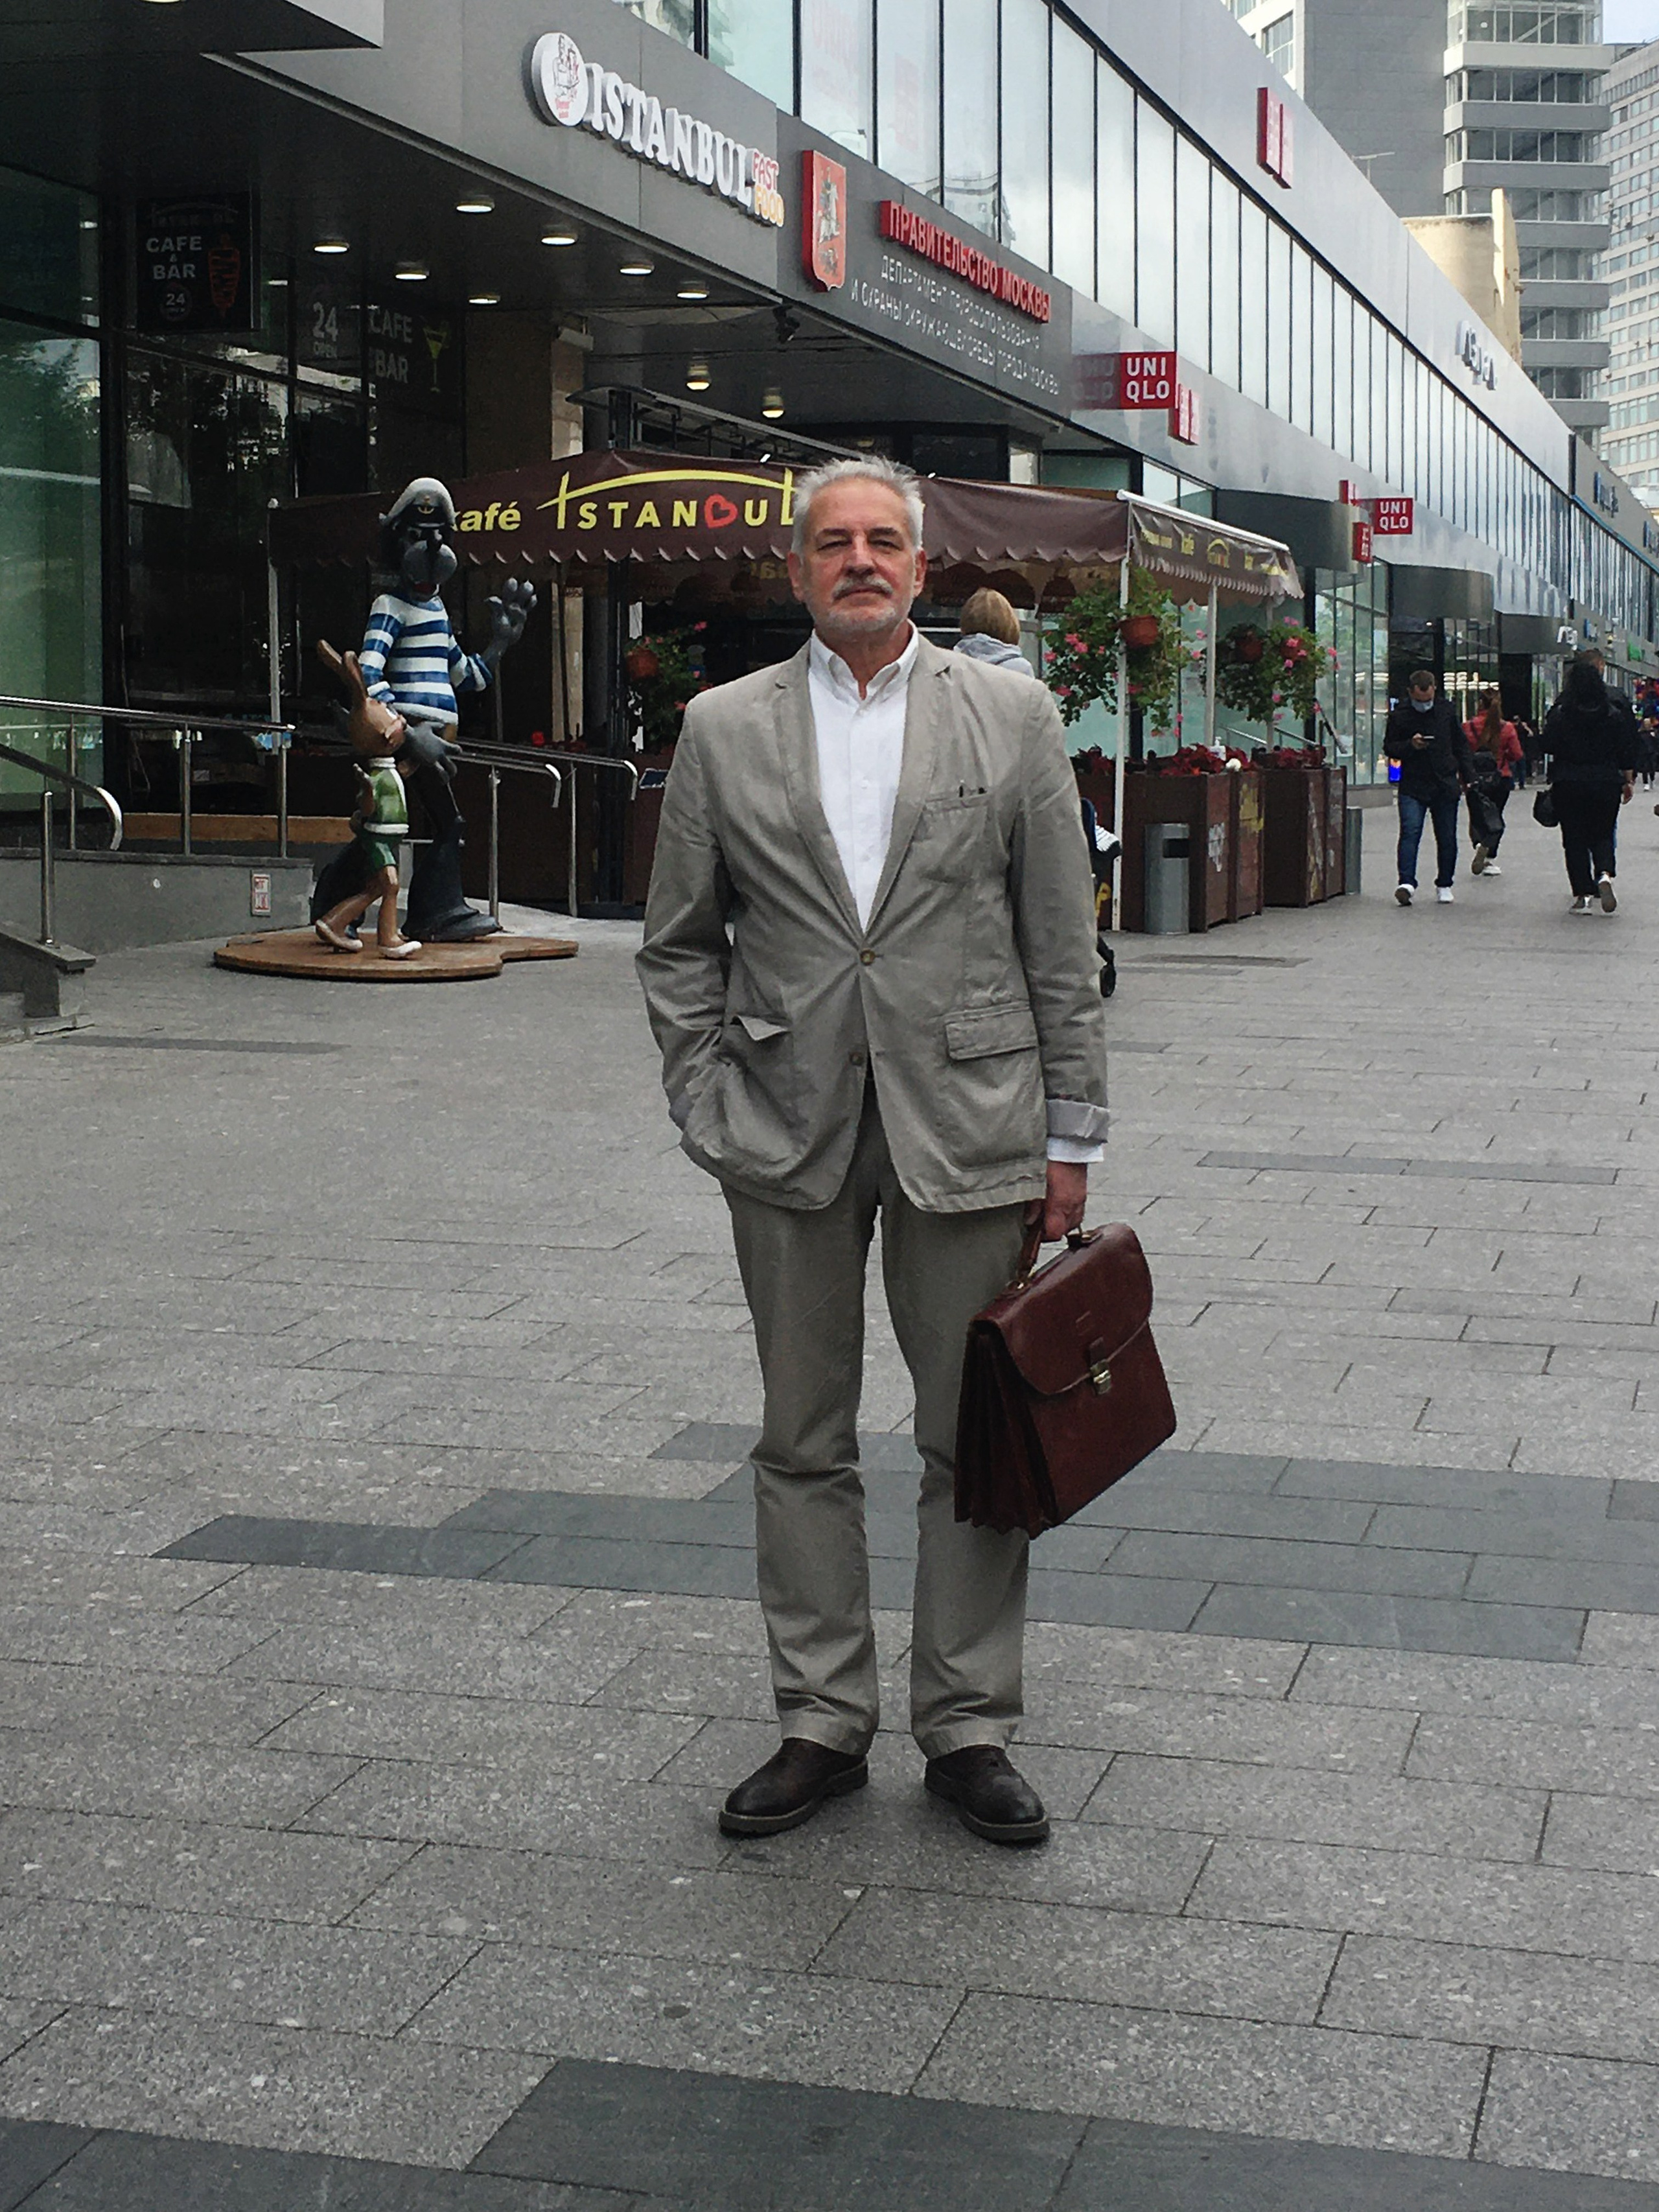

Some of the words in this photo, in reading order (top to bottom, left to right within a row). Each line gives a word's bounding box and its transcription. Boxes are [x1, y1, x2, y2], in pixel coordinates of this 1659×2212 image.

[588, 63, 752, 207] ISTANBUL
[752, 150, 778, 191] FAST
[755, 185, 784, 227] FOOD
[146, 235, 202, 253] CAFE
[152, 263, 196, 280] BAR
[887, 202, 998, 294] ПРАВИТЕЛЬСТВО
[1001, 266, 1051, 322] МОСКВЫ
[165, 292, 186, 307] 24
[851, 279, 858, 302] И
[312, 301, 339, 342] 24
[367, 307, 413, 344] CAFE
[375, 347, 409, 384] BAR
[1126, 356, 1166, 377] UNI
[1126, 380, 1170, 404] QLO
[452, 501, 522, 532] afé
[1380, 501, 1407, 515] UNI
[1379, 516, 1409, 531] QLO
